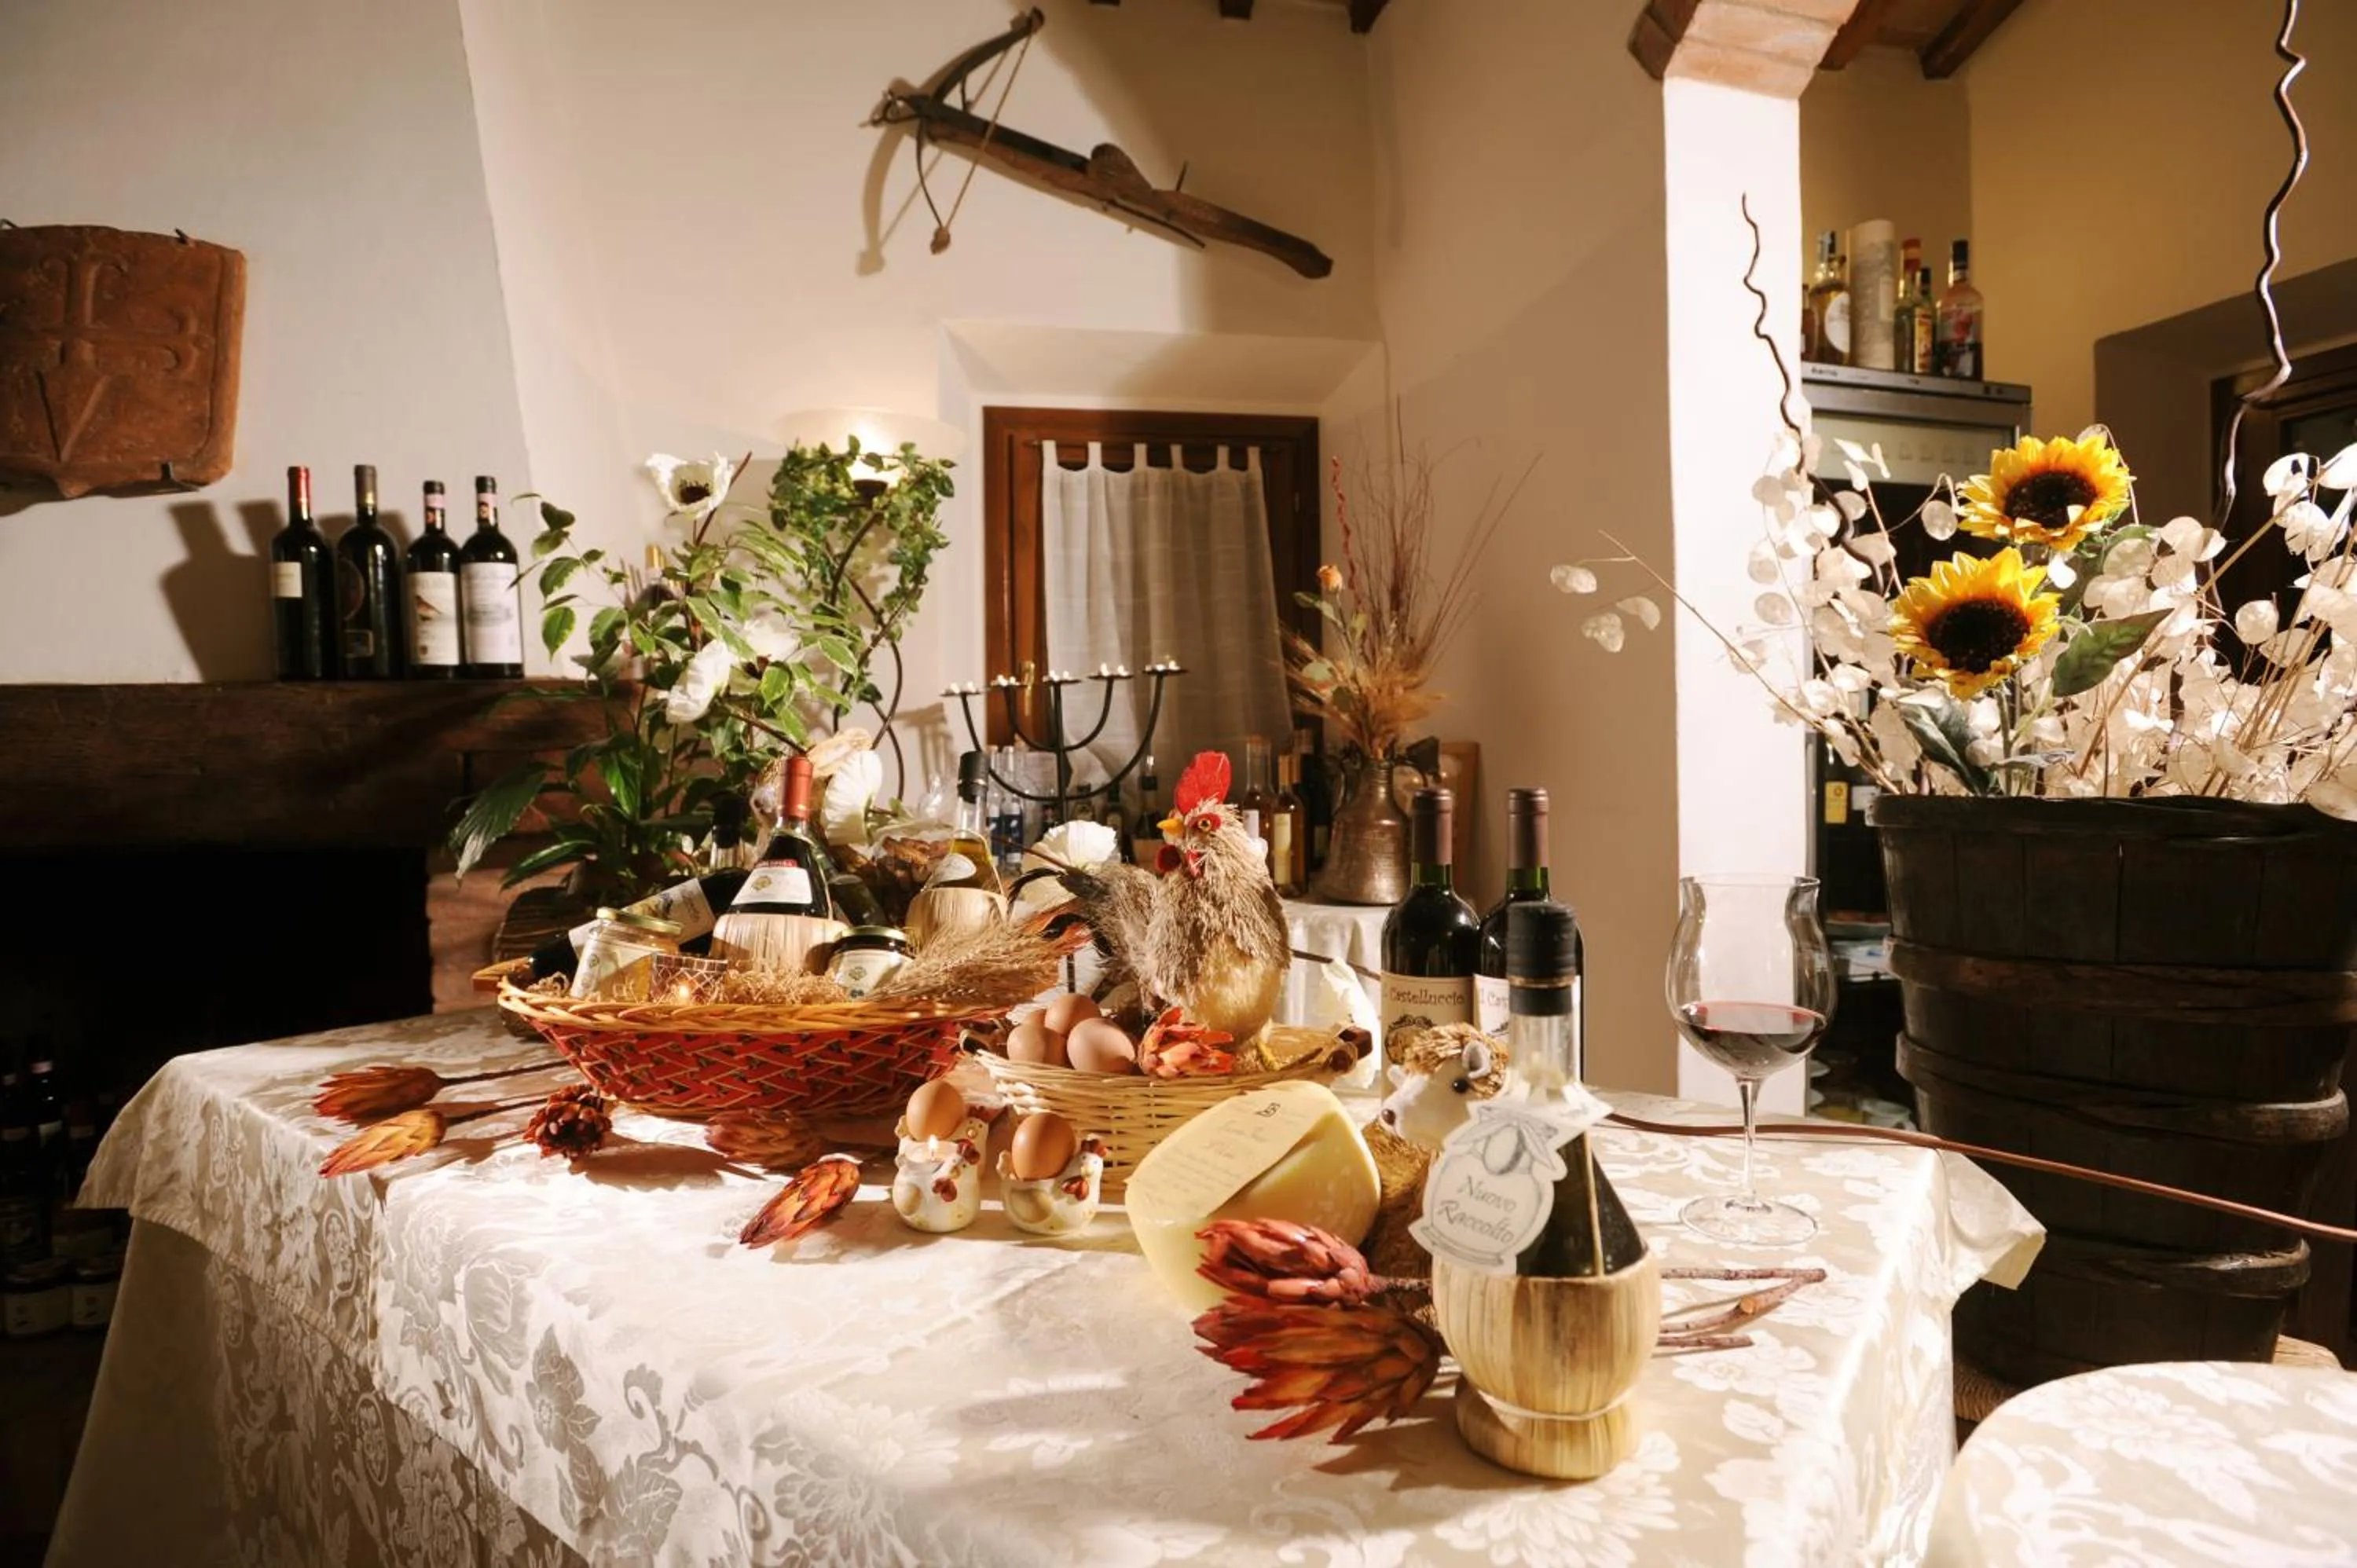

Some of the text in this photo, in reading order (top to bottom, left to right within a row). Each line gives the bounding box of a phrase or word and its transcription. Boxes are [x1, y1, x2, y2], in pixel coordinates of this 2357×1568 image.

[1390, 986, 1466, 1006] Castelluccio
[1457, 1174, 1517, 1214] Nuovo
[1436, 1199, 1516, 1244] Raccolto
